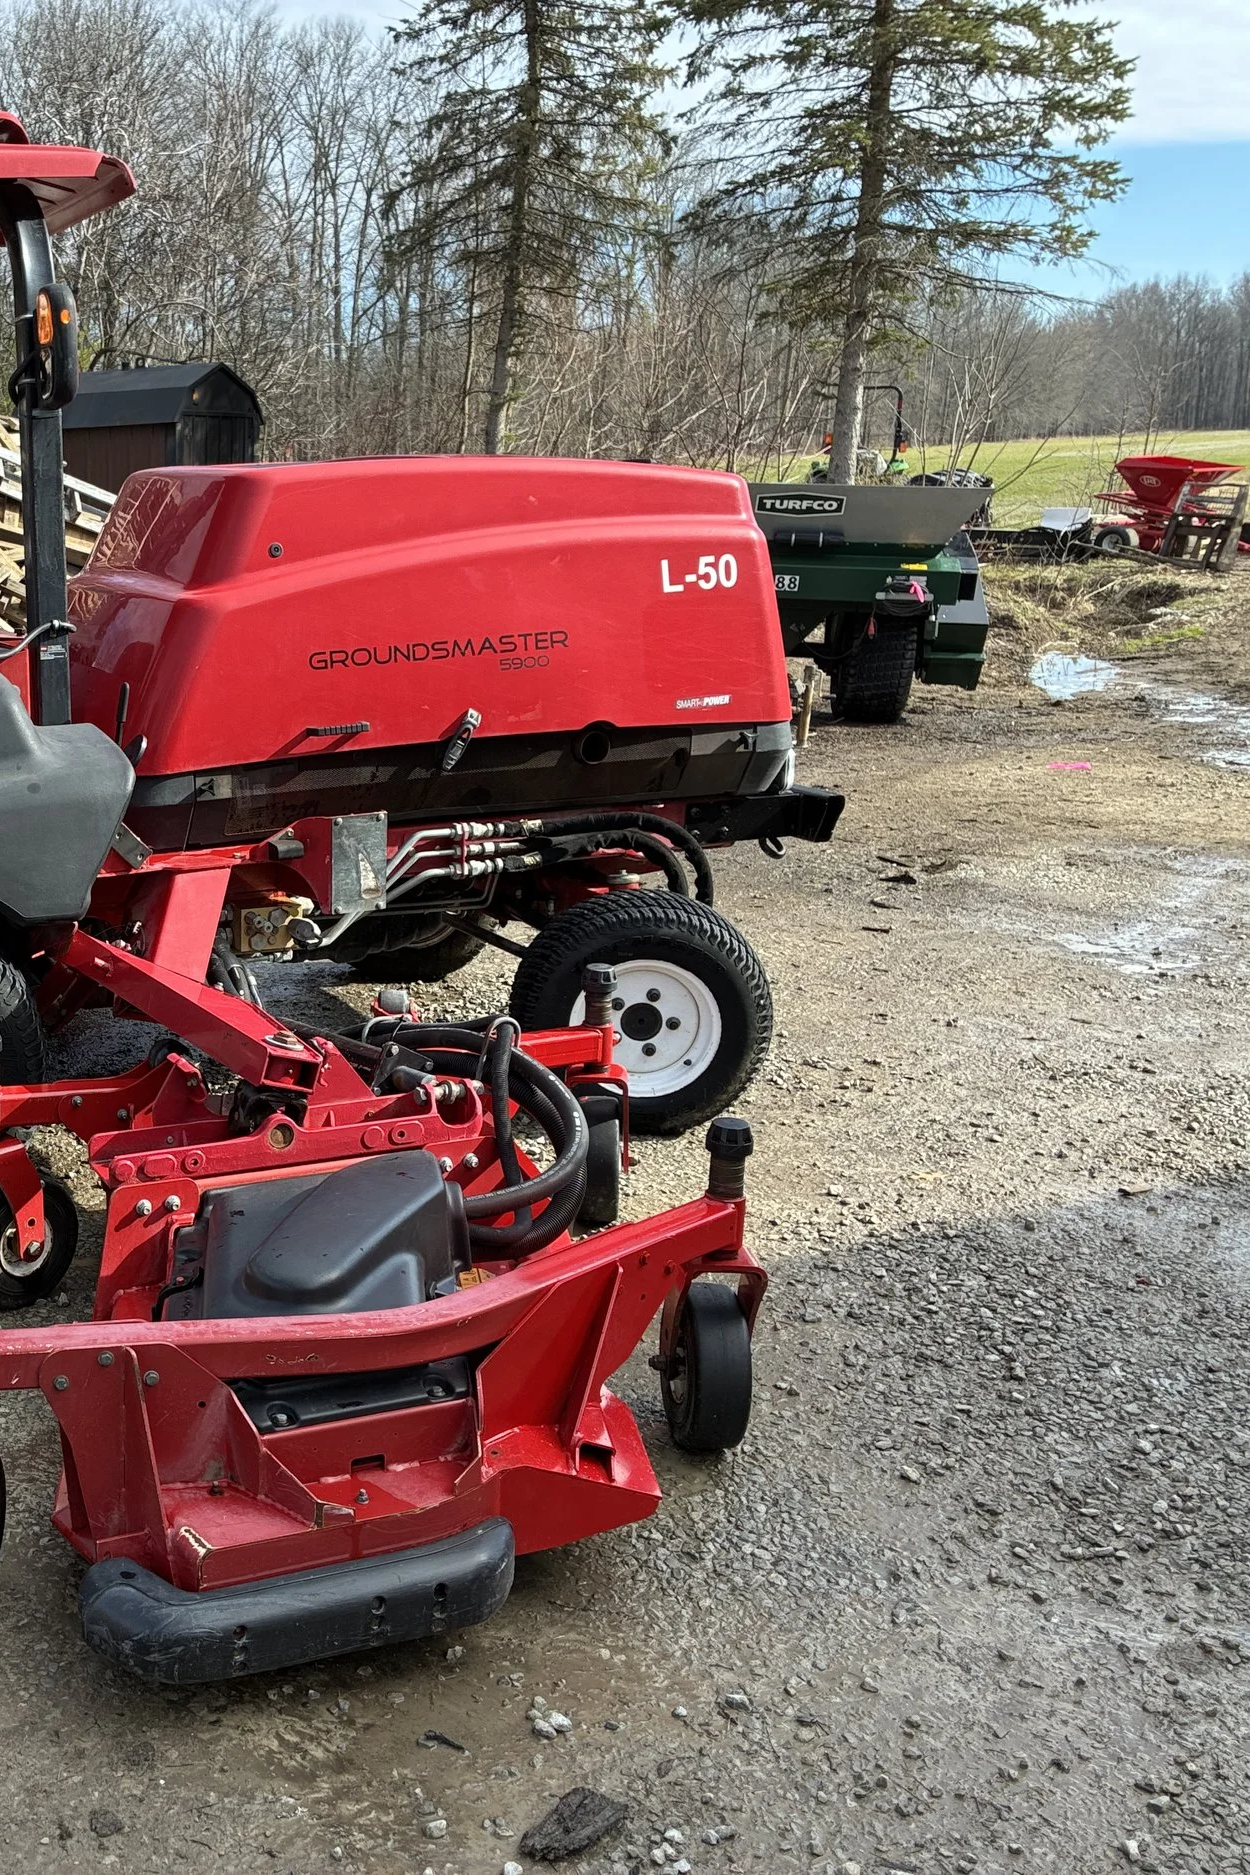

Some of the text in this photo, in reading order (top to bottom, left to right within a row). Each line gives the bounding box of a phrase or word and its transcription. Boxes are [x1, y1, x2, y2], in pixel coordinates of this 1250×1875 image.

[763, 499, 838, 511] TURFCO
[661, 553, 738, 593] L-50
[308, 630, 569, 671] GROUNDSMASTER
[500, 655, 550, 671] 5900
